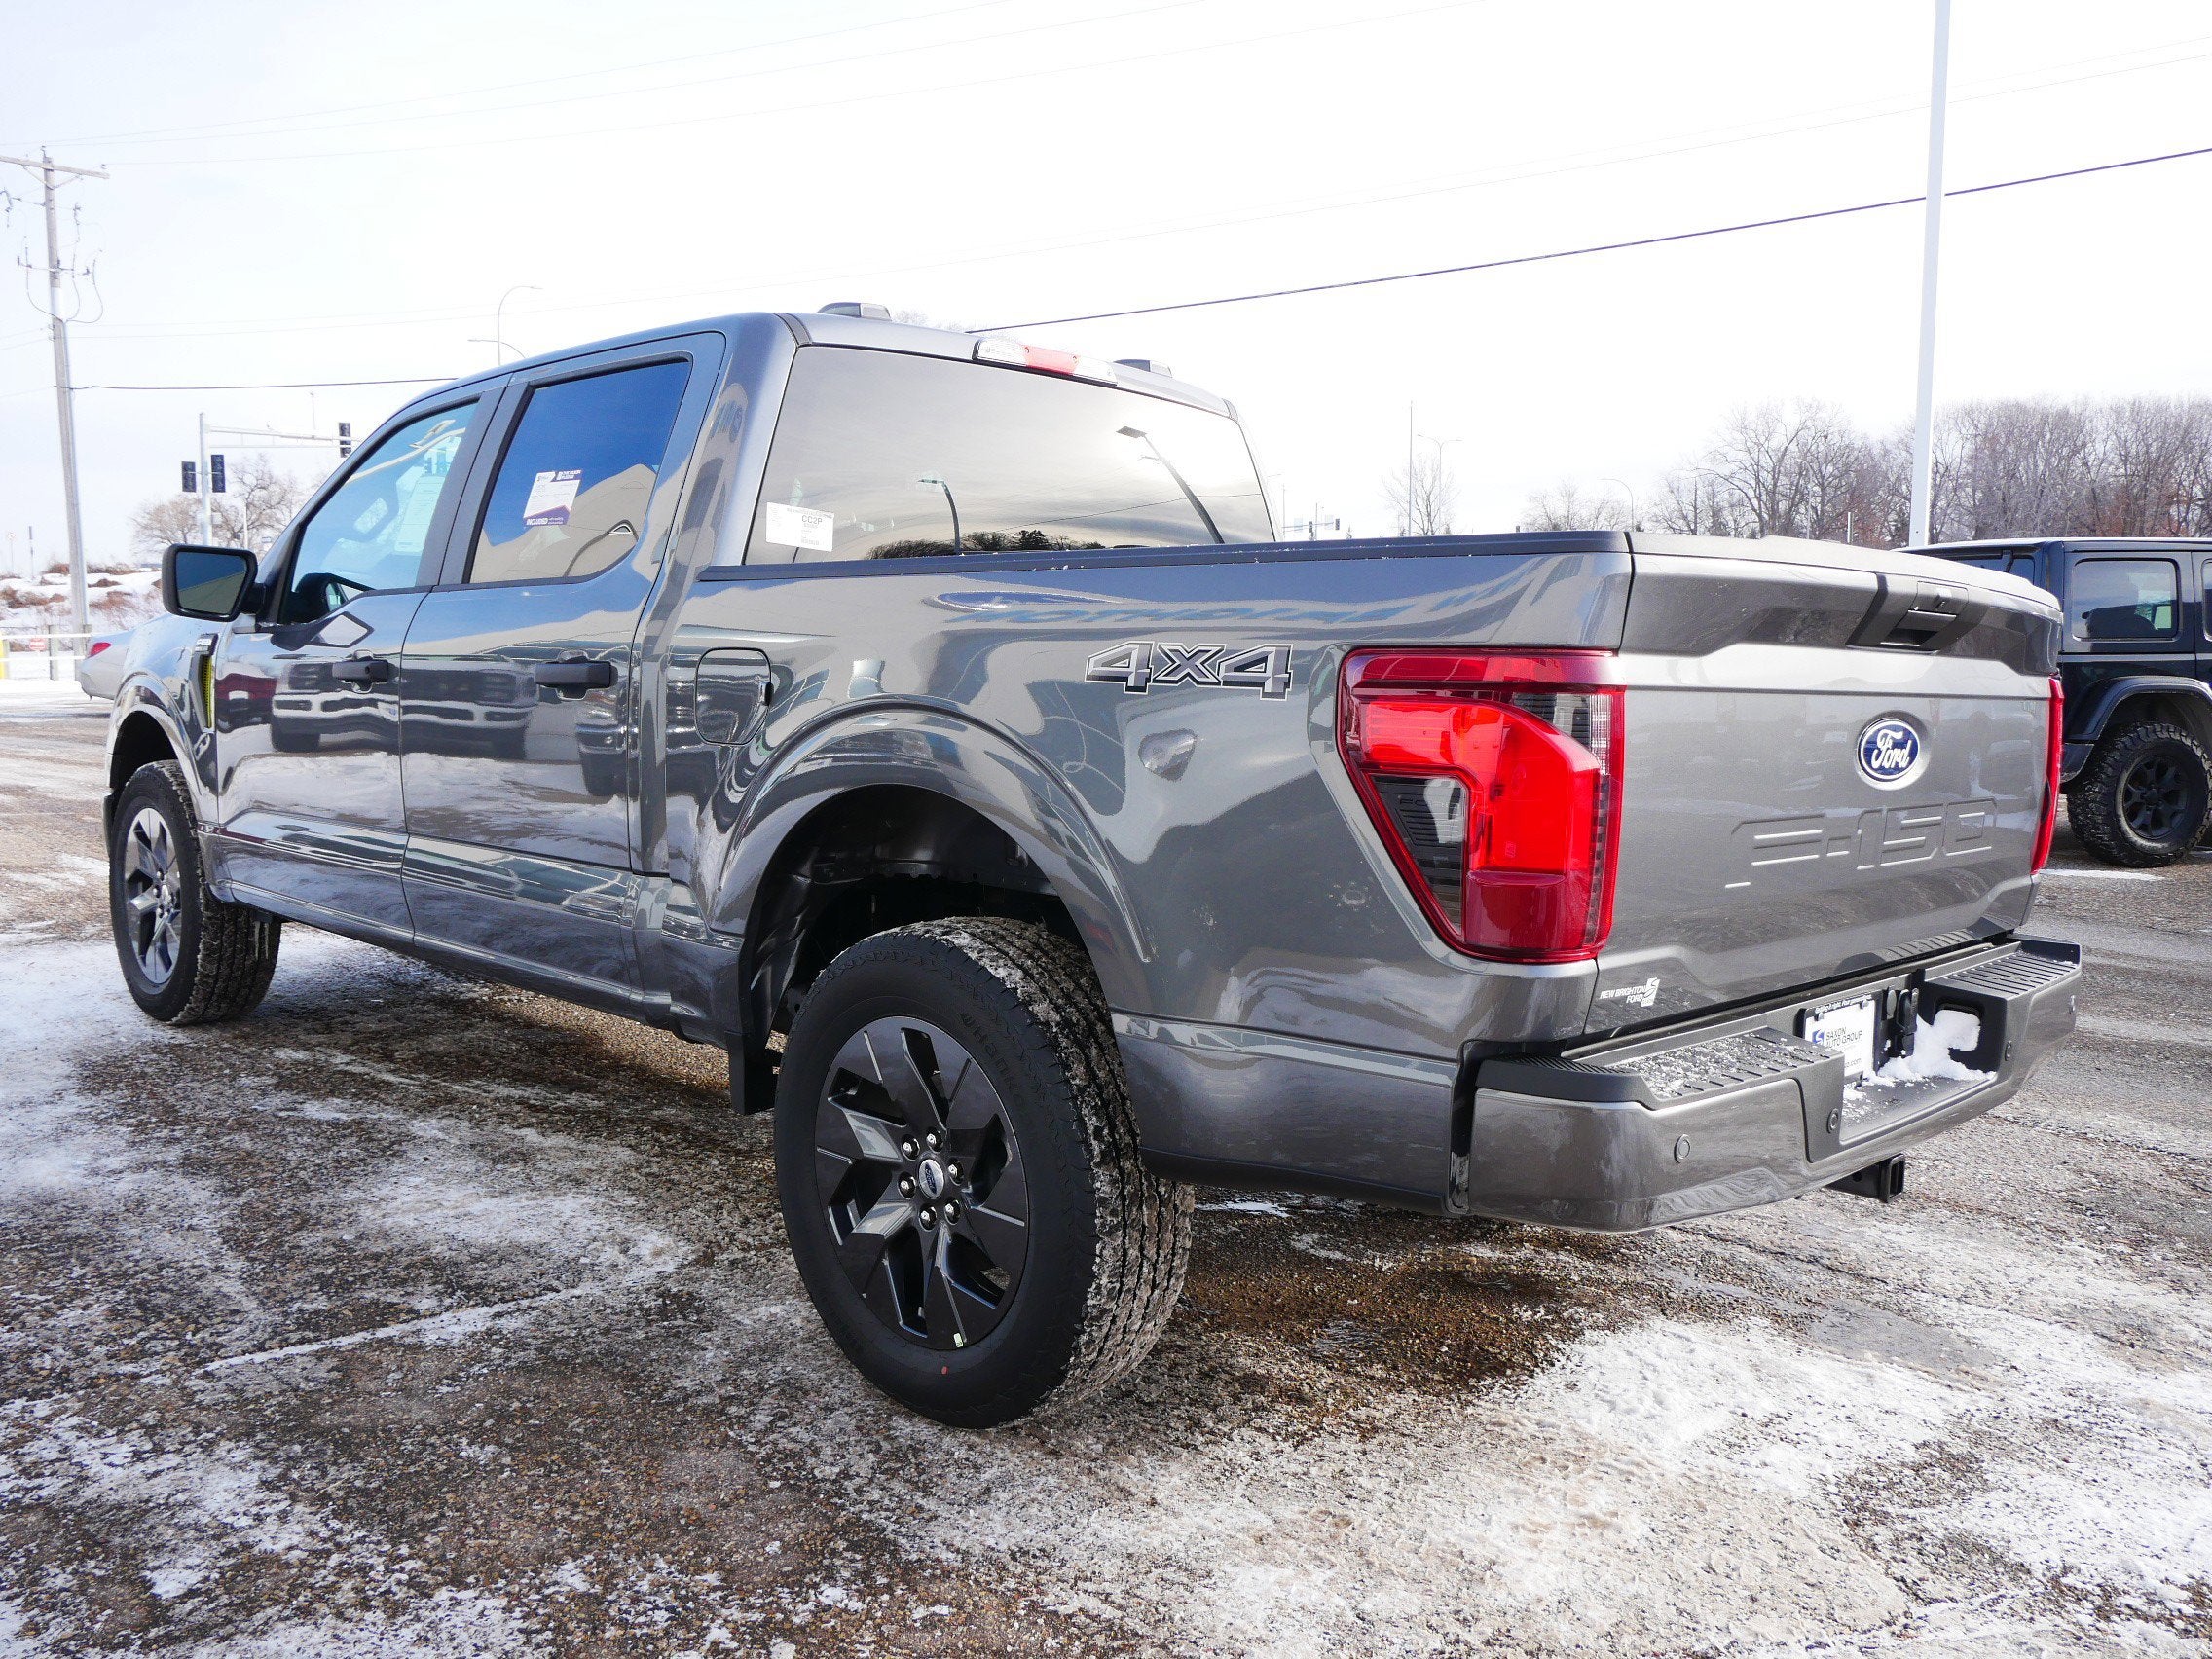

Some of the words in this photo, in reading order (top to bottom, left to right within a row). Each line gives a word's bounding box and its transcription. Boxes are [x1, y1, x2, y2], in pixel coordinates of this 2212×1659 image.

[1725, 796, 1998, 888] F-150
[1599, 990, 1615, 999] NEW
[1615, 985, 1646, 996] BRIGHTON
[1626, 993, 1642, 1003] FORD
[1826, 1027, 1847, 1041] SAXON
[1826, 1036, 1841, 1048] AUTO
[1842, 1030, 1862, 1044] GROUP
